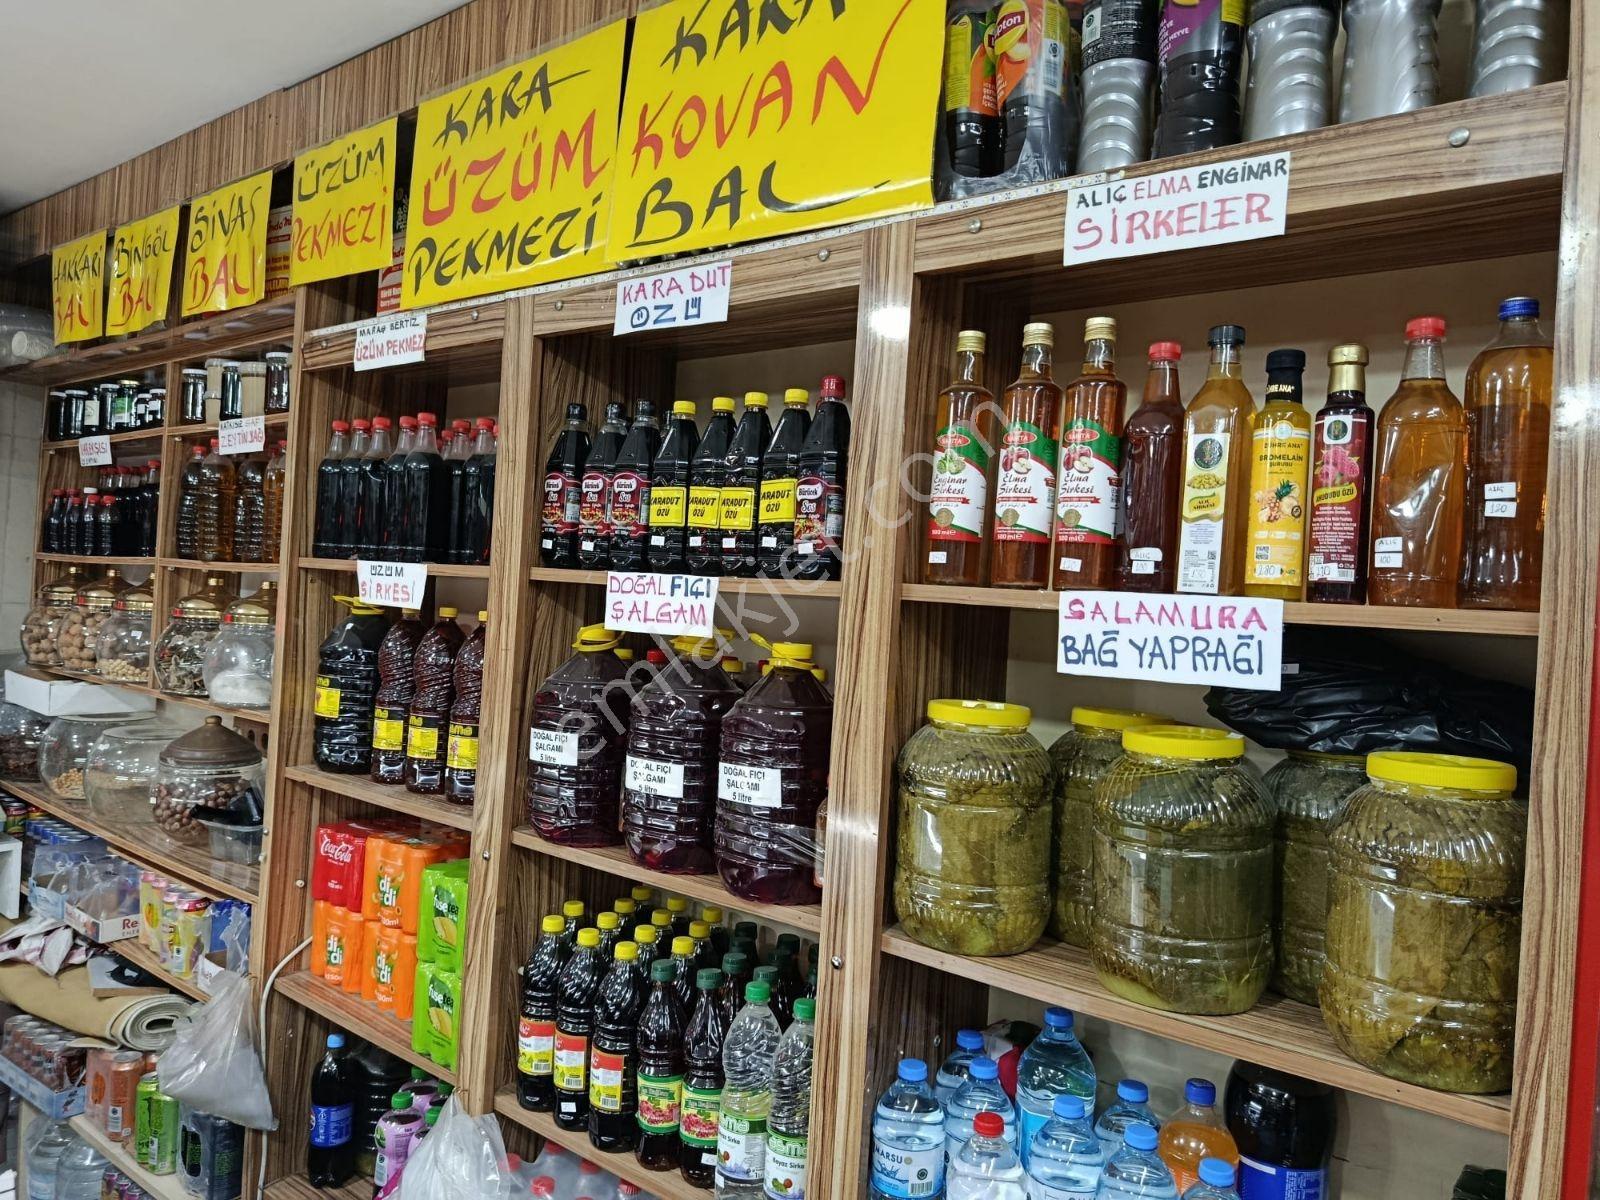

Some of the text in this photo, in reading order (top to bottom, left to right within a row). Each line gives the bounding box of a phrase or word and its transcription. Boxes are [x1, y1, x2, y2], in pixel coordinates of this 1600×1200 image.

[433, 62, 590, 150] KARA
[631, 0, 911, 176] KOVAN
[298, 136, 385, 202] ÜZÜM
[422, 109, 609, 227] ÜZÜM
[1076, 158, 1288, 209] ALIÇ ELMA ENGİNAR
[293, 186, 387, 263] PEKMEZİ
[408, 192, 603, 297] PEKMEZİ
[1073, 193, 1274, 251] SİRKELER
[115, 225, 170, 279] BİNGÖL
[186, 246, 256, 312] BALI
[623, 264, 731, 306] KARA DUT
[355, 338, 385, 362] ÜZÜM
[609, 575, 711, 600] DOĞAL FIÇI
[611, 600, 707, 626] ŞALGAM
[1064, 598, 1268, 632] SALAMURA
[1061, 630, 1263, 676] BAĞ YAPRAĞI
